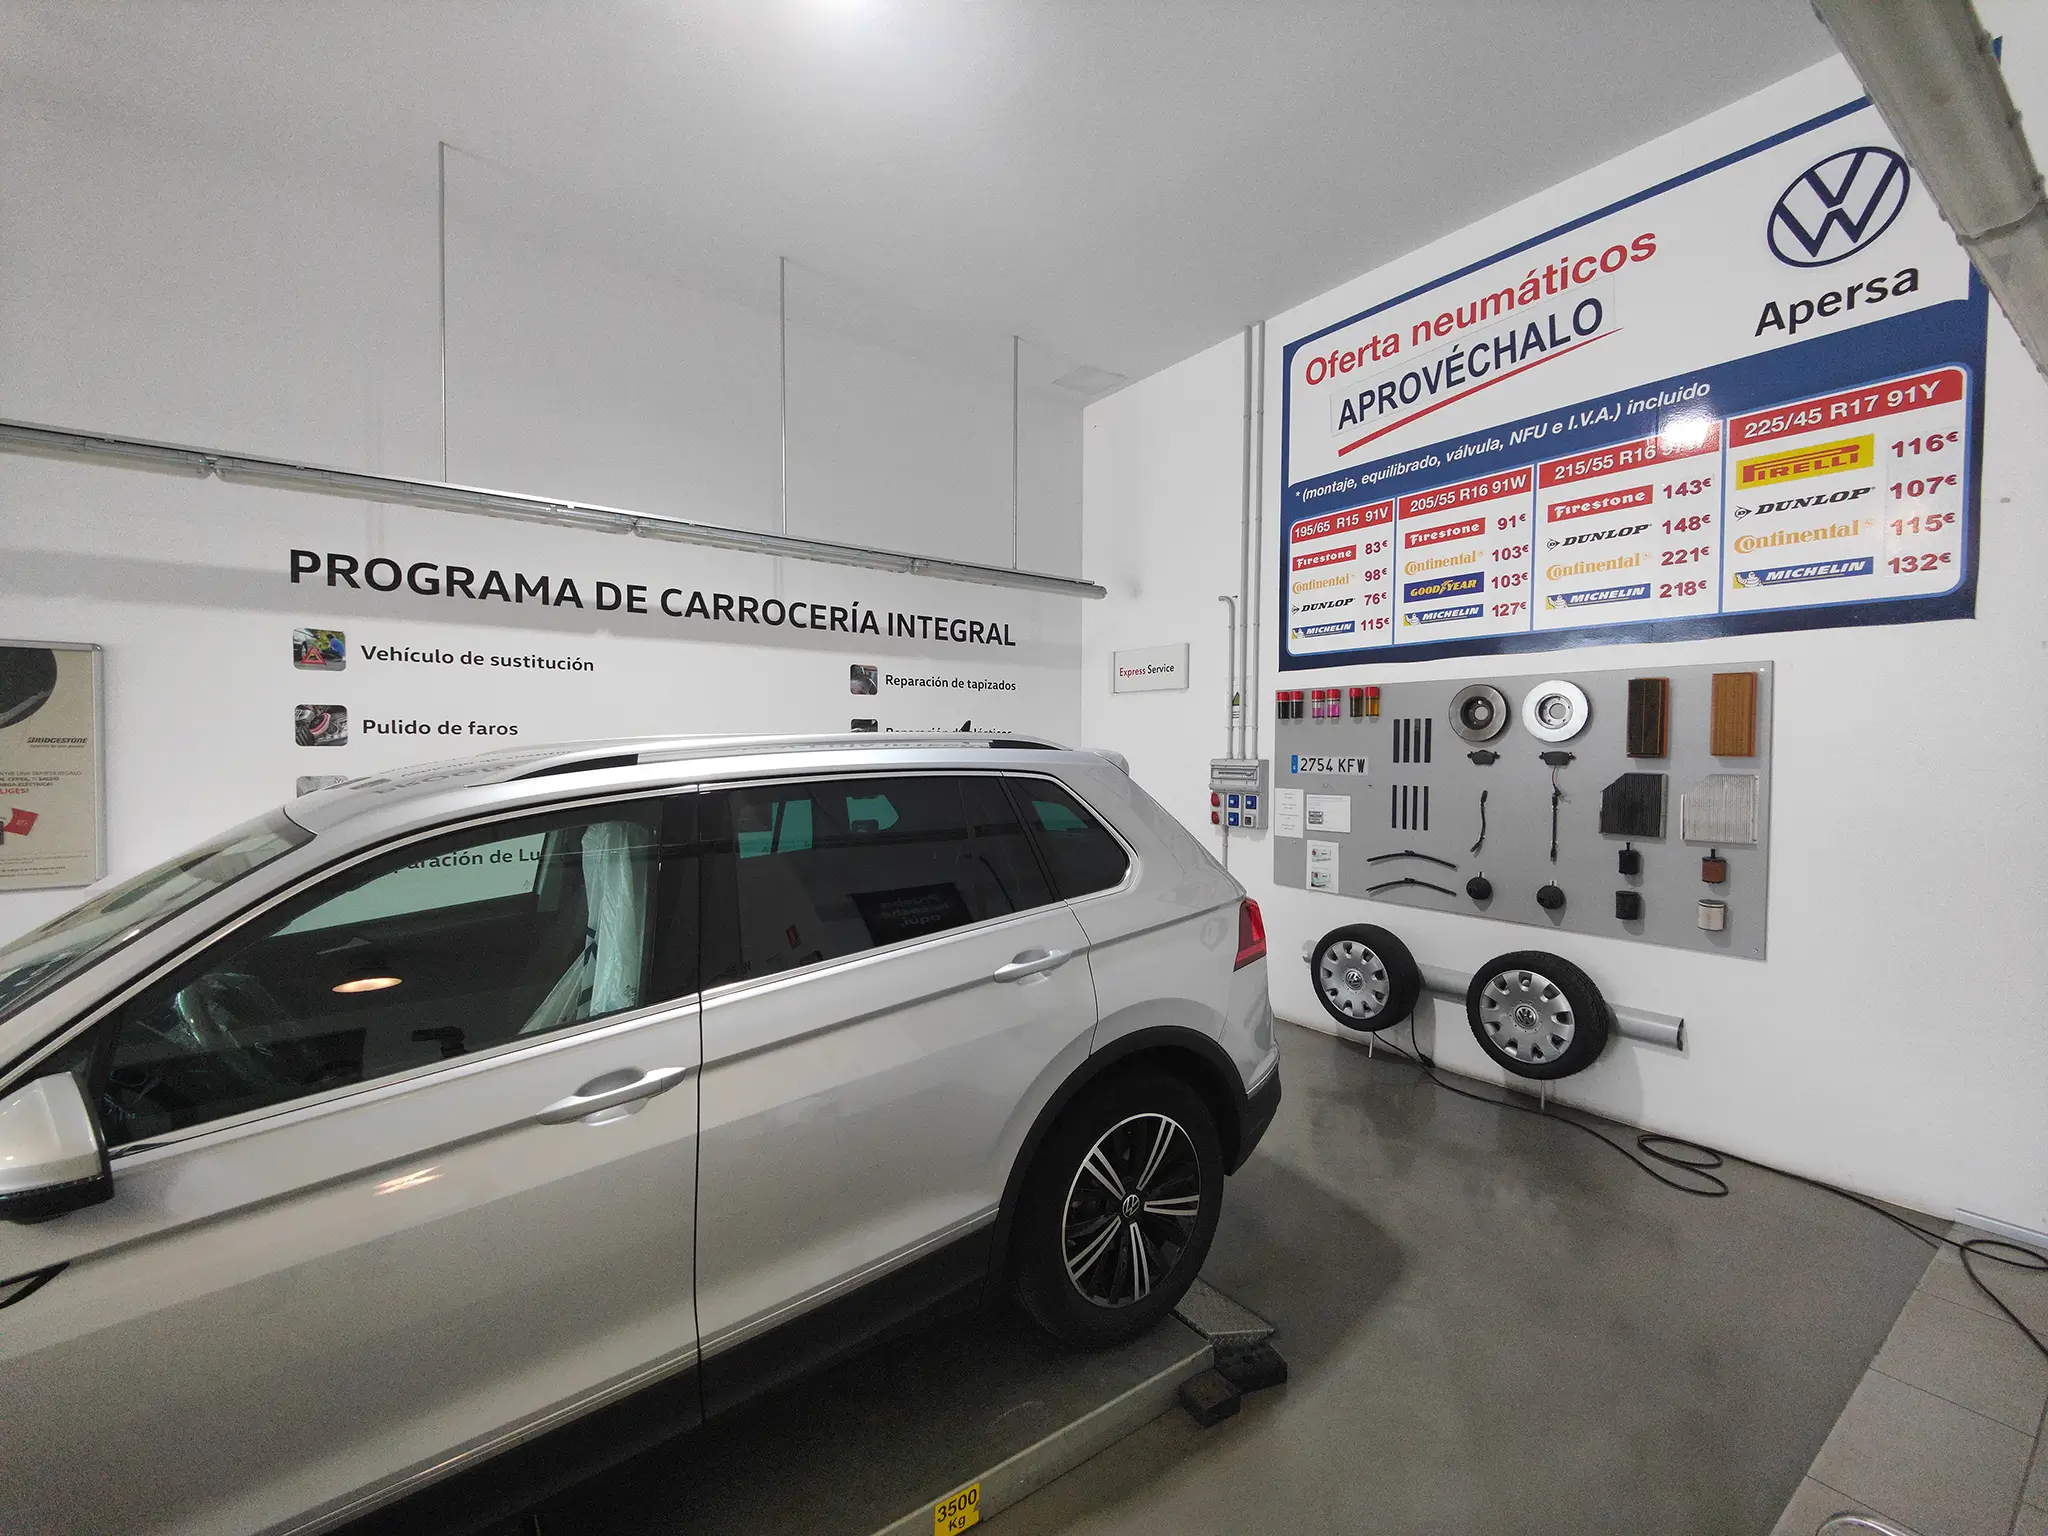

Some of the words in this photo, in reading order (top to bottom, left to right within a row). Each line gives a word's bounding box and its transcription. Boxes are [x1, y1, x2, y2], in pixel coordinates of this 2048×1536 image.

[1305, 331, 1400, 386] Oferta
[1411, 232, 1657, 347] neumáticos
[1754, 267, 1919, 338] Apersa
[1338, 297, 1603, 430] APROVÉCHALO
[1744, 407, 1823, 439] 225/45
[1830, 394, 1879, 420] R17
[1887, 379, 1942, 407] 91Y
[1302, 478, 1357, 503] (montaje,
[1361, 454, 1441, 485] equilibrado,
[1446, 437, 1504, 463] válvula,
[1509, 422, 1548, 446] NFU
[1551, 424, 1563, 435] e
[1568, 403, 1621, 431] I.V.A.)
[1626, 382, 1711, 416] incluido
[1742, 443, 1860, 484] PIRELLI
[1891, 431, 1959, 458] 116€
[1554, 456, 1614, 481] 215/55
[1619, 445, 1657, 466] R16
[1409, 491, 1456, 513] 205/55
[1460, 484, 1488, 501] R16
[1492, 474, 1527, 493] 91W
[1553, 491, 1646, 519] Firestone
[1663, 477, 1712, 499] 143€
[1755, 486, 1872, 516] DUNLOP
[1890, 474, 1957, 500] 107€
[1294, 521, 1331, 538] 195/65
[1336, 514, 1359, 529] R15
[1365, 506, 1389, 522] 91V
[1409, 523, 1480, 546] Firestone
[1497, 513, 1526, 531] 91€
[1562, 523, 1650, 547] DUNLOP
[1662, 514, 1711, 535] 148€
[1733, 519, 1860, 554] Continental
[1890, 512, 1956, 536] 115€
[1296, 549, 1352, 568] Firestone
[1365, 540, 1388, 555] 83€
[1404, 550, 1477, 576] Continental
[1492, 544, 1529, 562] 103€
[1546, 552, 1641, 581] Continental
[1661, 546, 1710, 567] 221€
[1765, 560, 1866, 582] MICHELIN
[1888, 552, 1952, 574] 132€
[1292, 573, 1350, 595] Continental
[1364, 568, 1387, 582] 98€
[1491, 572, 1528, 589] 103€
[1570, 586, 1646, 603] MICHELIN
[1659, 579, 1707, 599] 218€
[290, 549, 584, 609] PROGRAMA
[595, 581, 648, 614] DE
[660, 588, 880, 635] CARROCERÍA
[888, 612, 1016, 647] INTEGRAL
[1301, 598, 1354, 612] DUNLOP
[1364, 592, 1387, 606] 76€
[1422, 606, 1480, 621] MICHELIN
[1492, 601, 1527, 618] 127€
[1306, 623, 1352, 635] MICHELIN
[1360, 617, 1389, 631] 115€
[360, 645, 454, 665] Vehículo
[460, 651, 485, 666] de
[490, 654, 595, 672] sustitución
[1119, 667, 1146, 678] Express
[1147, 663, 1175, 675] Service
[885, 674, 949, 689] Reparación
[951, 677, 965, 689] de
[967, 679, 1017, 692] tapizados
[27, 736, 88, 744] BRIDGESTONE
[362, 719, 431, 736] Pulido
[437, 720, 463, 736] de
[468, 721, 519, 736] faros
[1300, 757, 1333, 772] 2754
[1338, 758, 1366, 773] KFW
[395, 851, 483, 874] aración
[489, 850, 513, 864] de
[519, 848, 541, 862] Lu
[937, 1488, 977, 1523] 3500
